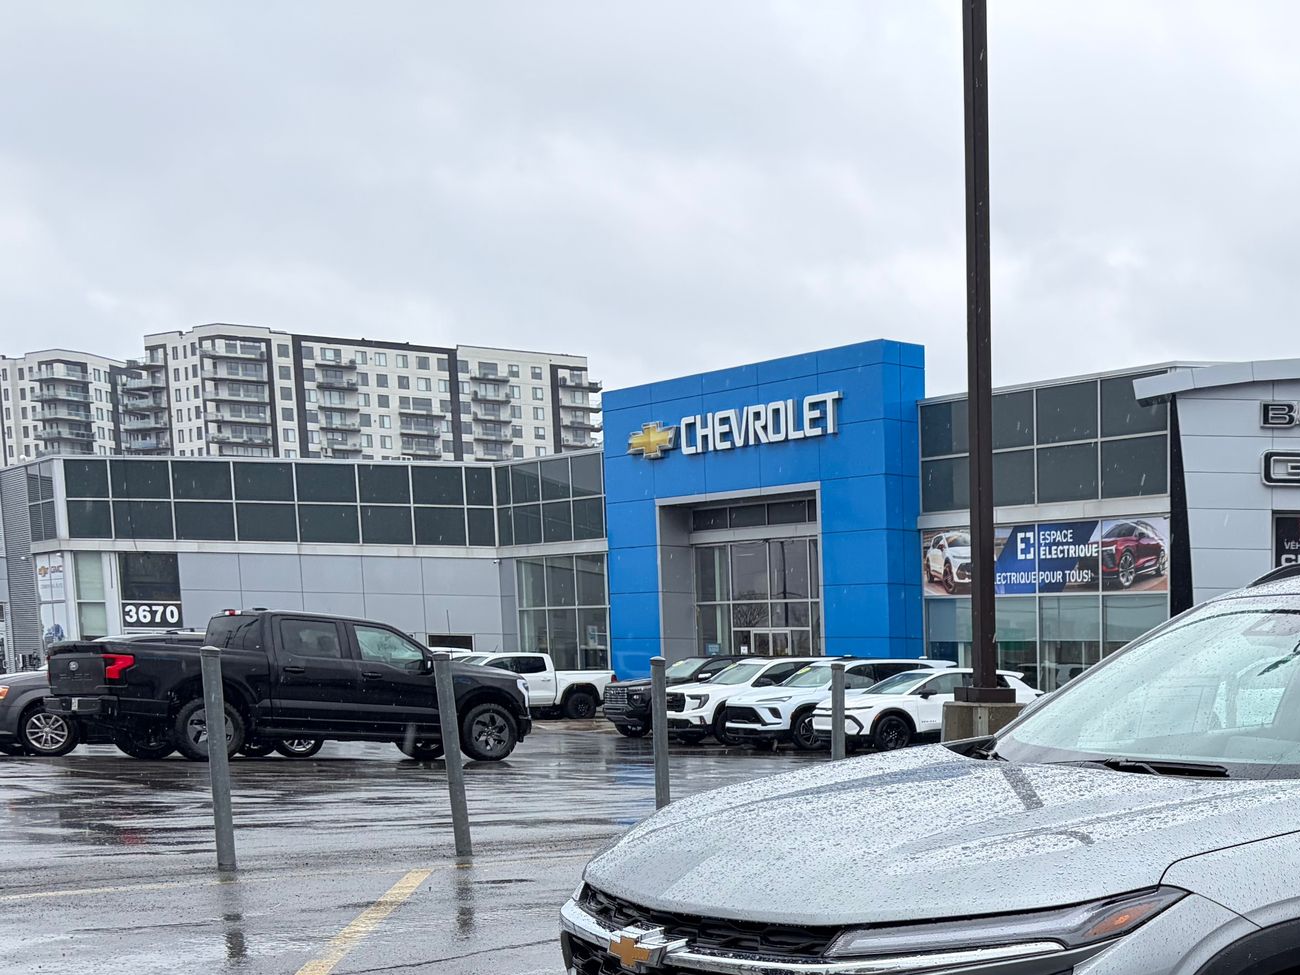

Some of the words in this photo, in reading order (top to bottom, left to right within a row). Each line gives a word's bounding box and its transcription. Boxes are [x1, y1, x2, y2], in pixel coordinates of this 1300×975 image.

[680, 391, 842, 455] CHEVROLET
[1040, 530, 1073, 543] ESPACE
[1040, 543, 1098, 559] ÉLECTRIQUE
[1039, 571, 1063, 583] POUR
[1065, 569, 1091, 582] TOUS!
[124, 604, 179, 623] 3670
